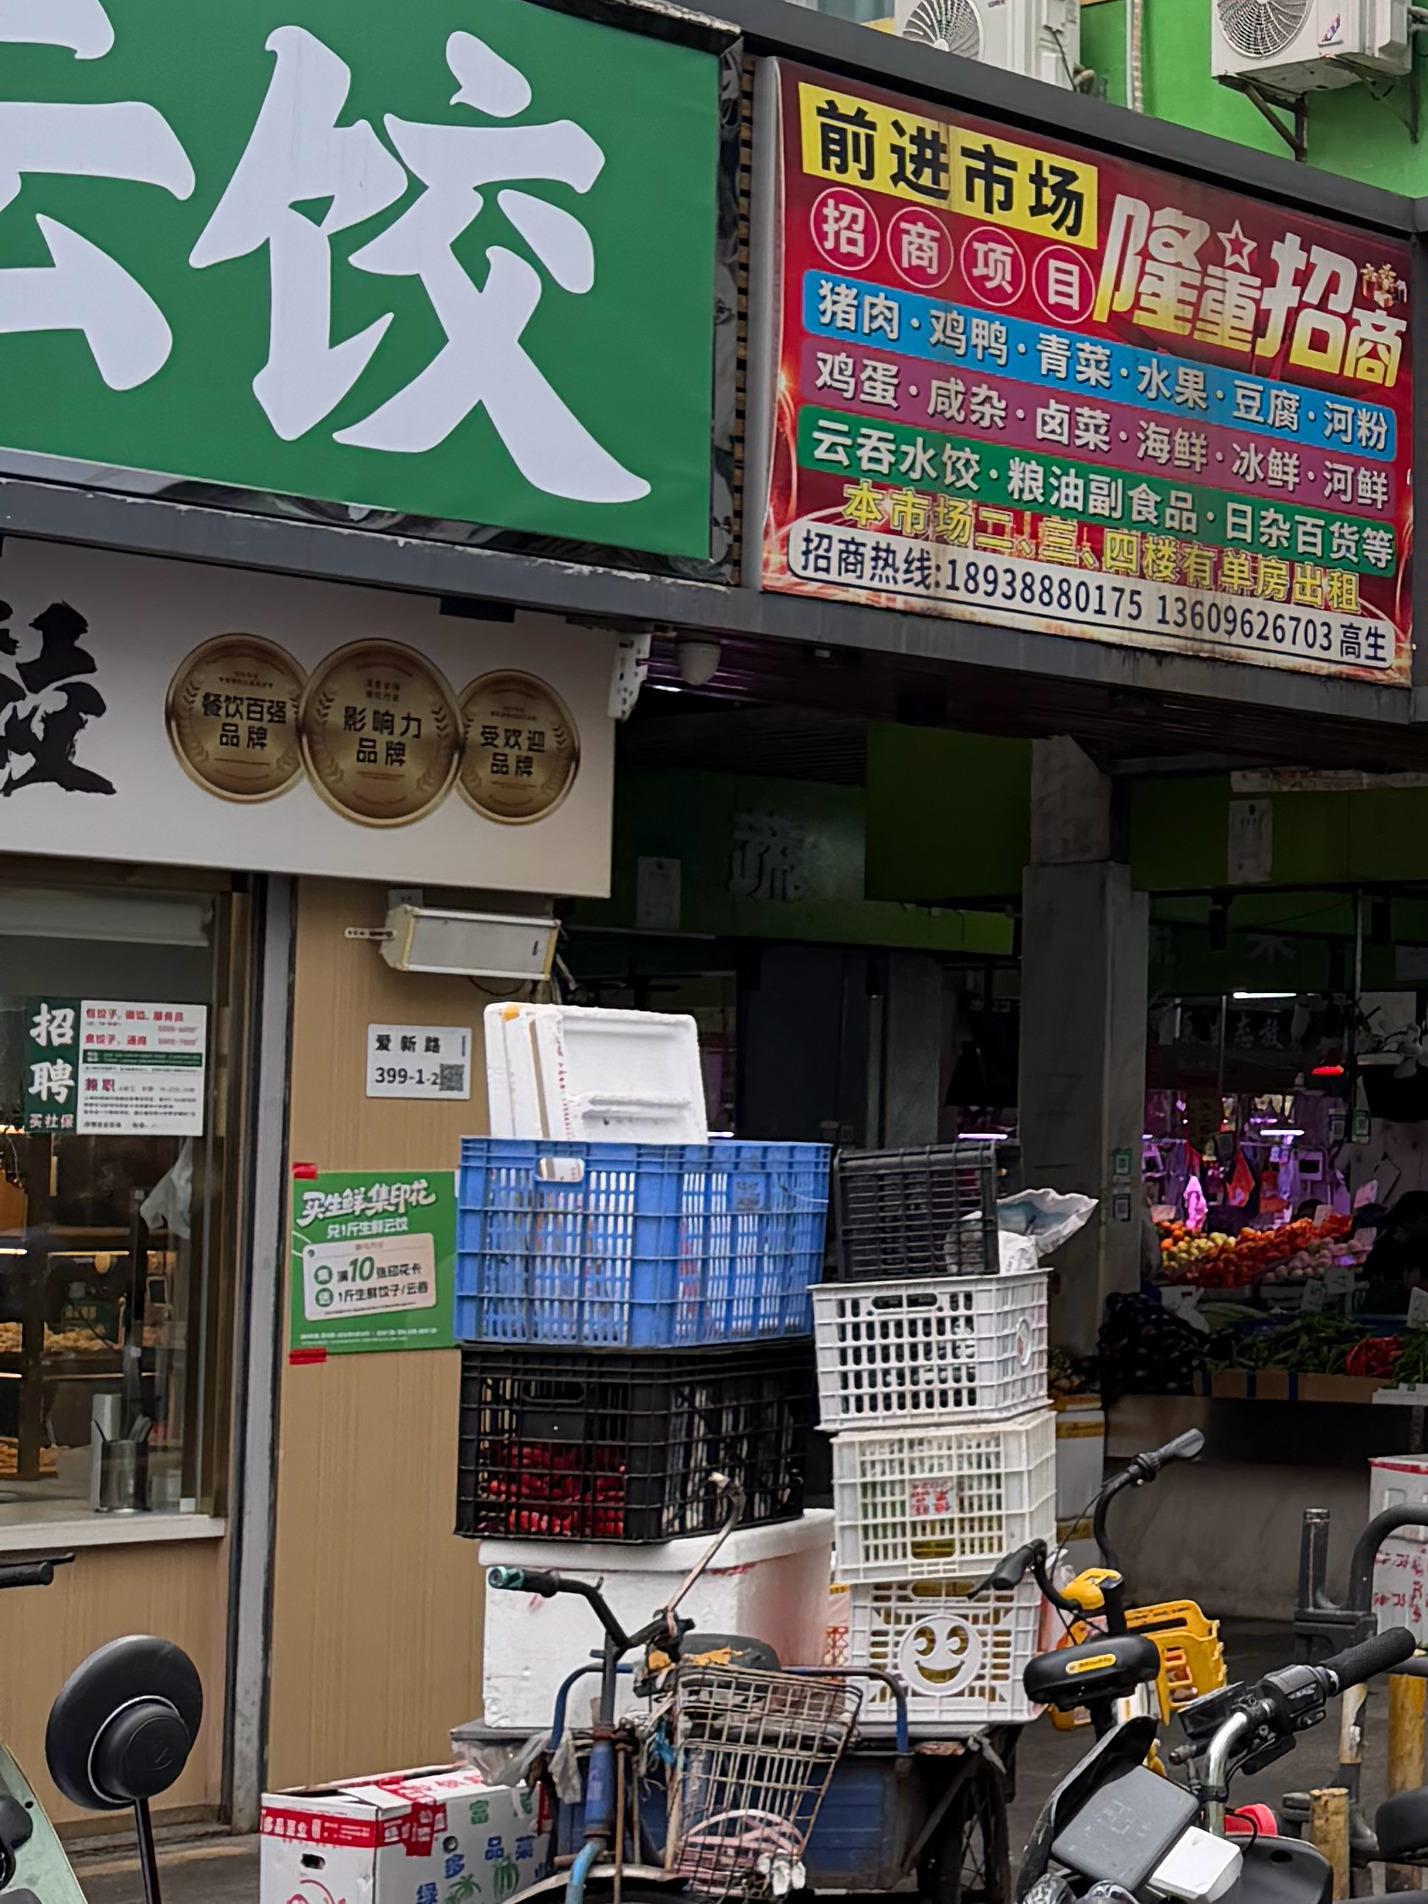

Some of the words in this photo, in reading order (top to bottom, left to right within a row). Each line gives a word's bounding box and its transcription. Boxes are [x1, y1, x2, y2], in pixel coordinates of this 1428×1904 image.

[813, 99, 1086, 238] 前进市场
[820, 197, 1083, 314] 招商项目
[1093, 193, 1408, 389] 隆重招商
[1155, 594, 1333, 653] 13609626703
[1338, 622, 1387, 663] 高生
[201, 691, 288, 726] 餐饮百强
[342, 704, 423, 740] 影响力
[218, 722, 269, 751] 品牌
[355, 738, 406, 767] 品牌
[479, 724, 546, 754] 受欢迎
[489, 752, 534, 778] 品牌
[27, 1002, 76, 1105] 招聘
[374, 1034, 441, 1053] 爱新路
[374, 1066, 440, 1086] 399-1-2
